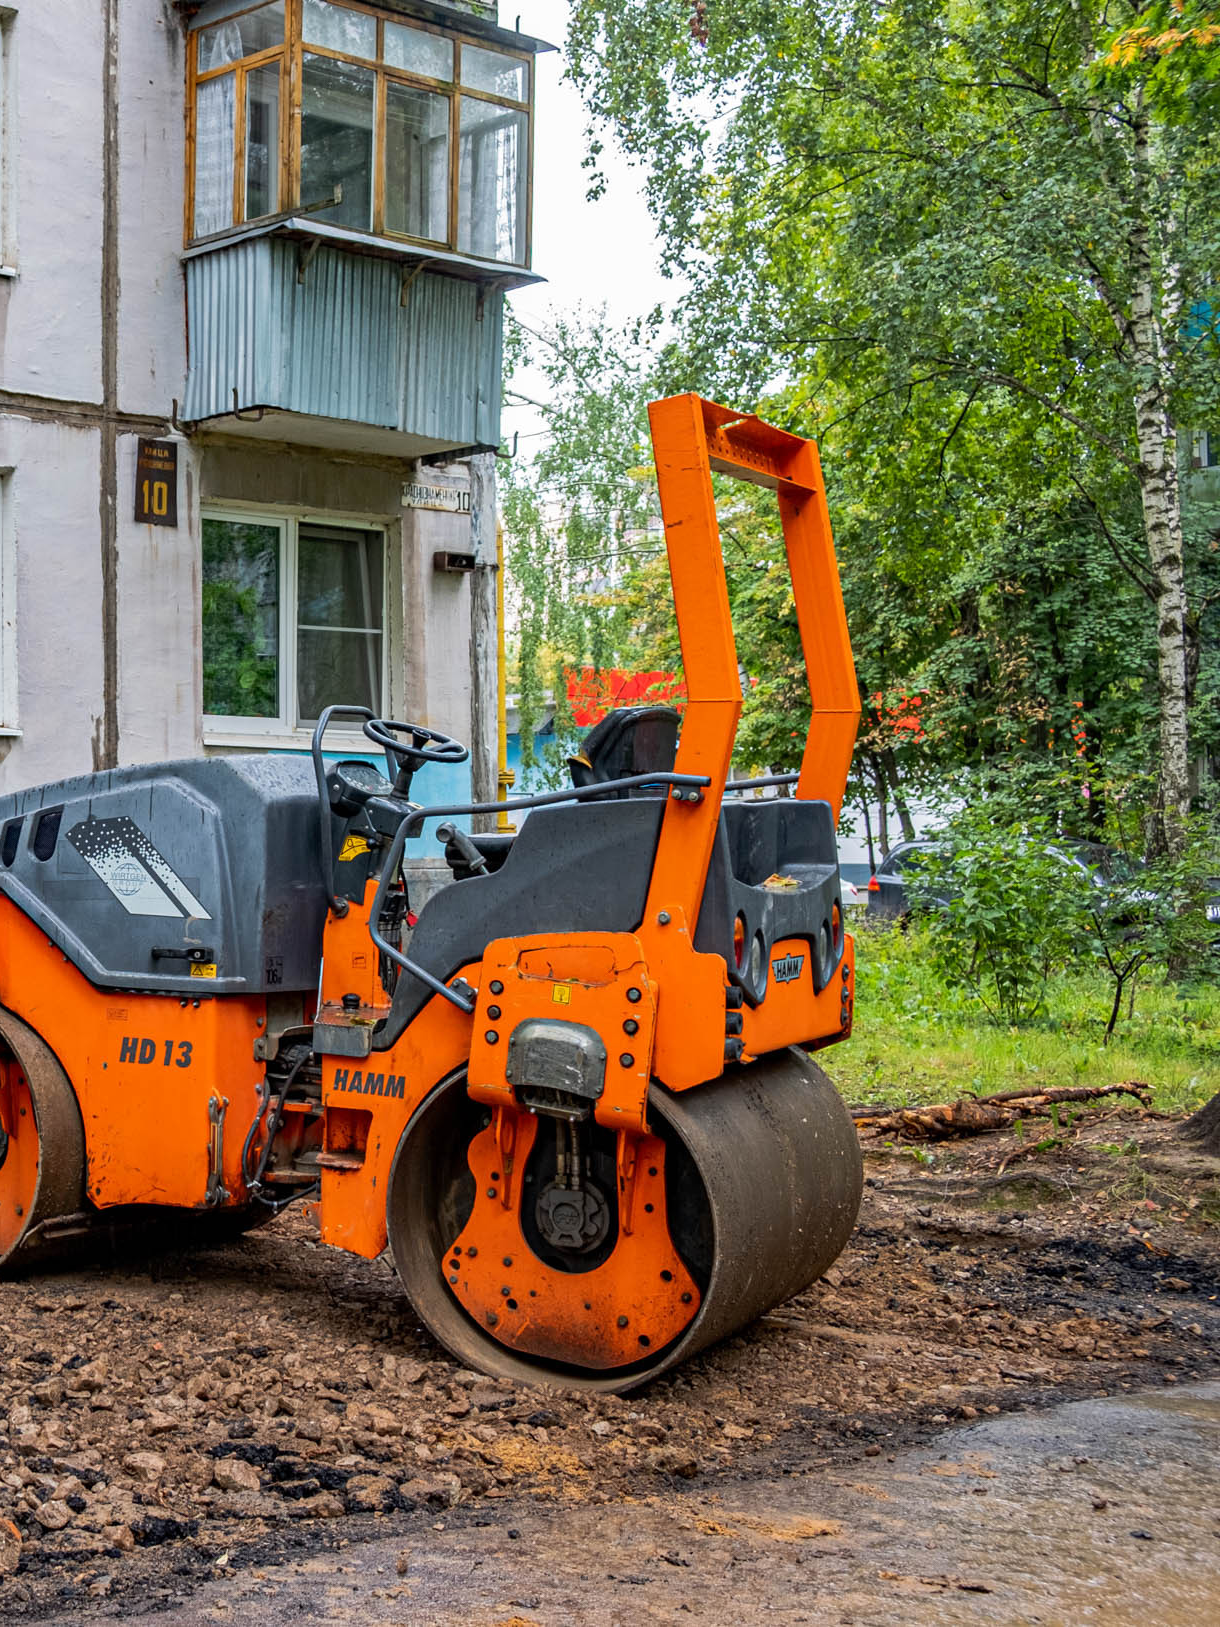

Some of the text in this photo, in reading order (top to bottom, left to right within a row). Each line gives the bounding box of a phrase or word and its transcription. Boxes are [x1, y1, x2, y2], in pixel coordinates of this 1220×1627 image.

[142, 479, 168, 515] 10
[457, 490, 470, 511] 10
[110, 871, 147, 881] WIRTGEN
[776, 960, 799, 978] HAMM
[119, 1037, 193, 1068] HD 13
[333, 1068, 406, 1099] HAMM
